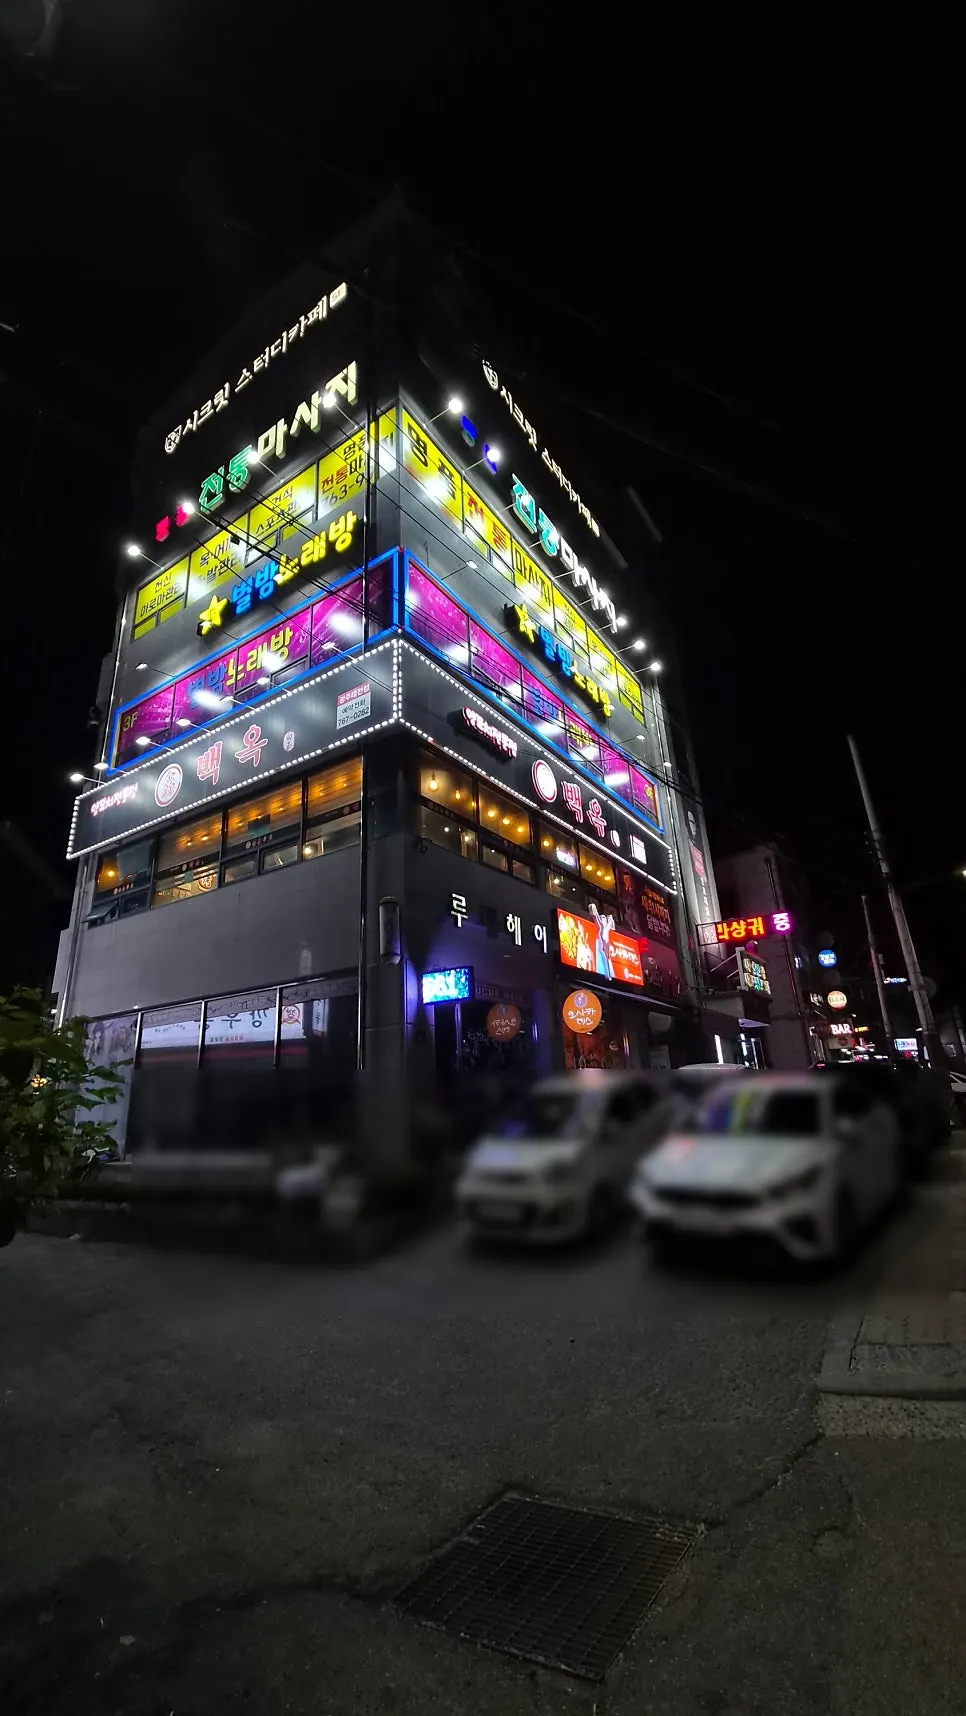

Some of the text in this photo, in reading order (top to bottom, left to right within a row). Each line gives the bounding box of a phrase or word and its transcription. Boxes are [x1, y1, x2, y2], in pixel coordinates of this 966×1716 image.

[182, 382, 231, 436] 시크릿
[235, 294, 328, 393] 스터디카페
[123, 711, 139, 732] 3F
[828, 995, 845, 1004] BAR
[830, 1023, 853, 1036] BAR
